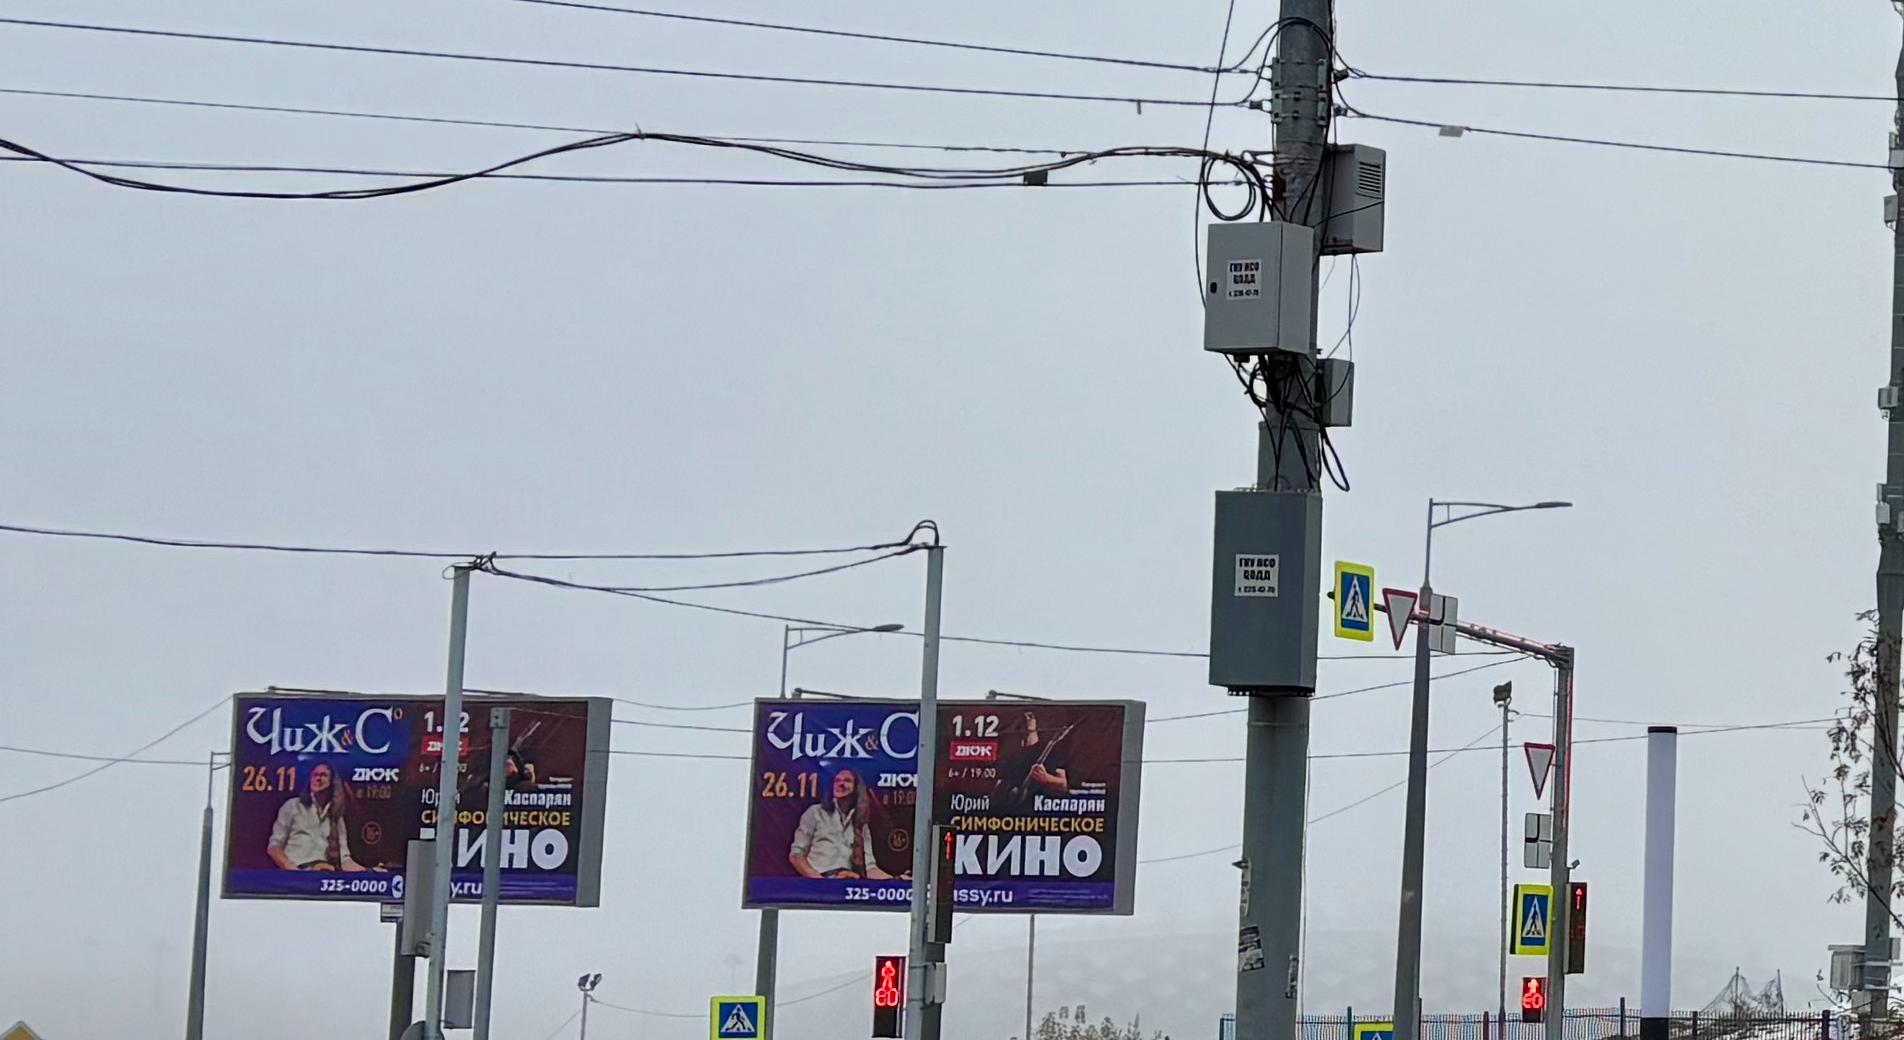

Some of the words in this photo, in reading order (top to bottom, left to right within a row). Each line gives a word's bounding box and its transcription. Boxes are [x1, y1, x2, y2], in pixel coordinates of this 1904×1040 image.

[424, 711, 470, 733] 1.2
[952, 715, 999, 737] 1.12
[242, 765, 297, 792] 26.11
[762, 771, 818, 798] 26.11
[503, 790, 571, 809] Каспарян
[951, 793, 990, 813] Юрий
[1034, 794, 1105, 815] Каспарян
[421, 810, 571, 826] СФОЧЕСКОЕ
[951, 816, 1104, 833] СИМФОНИЧЕСКОЕ
[420, 827, 569, 870] ИНО
[955, 835, 1103, 878] КИНО
[320, 879, 388, 893] 325-0000
[953, 889, 1013, 906] ssy.ru
